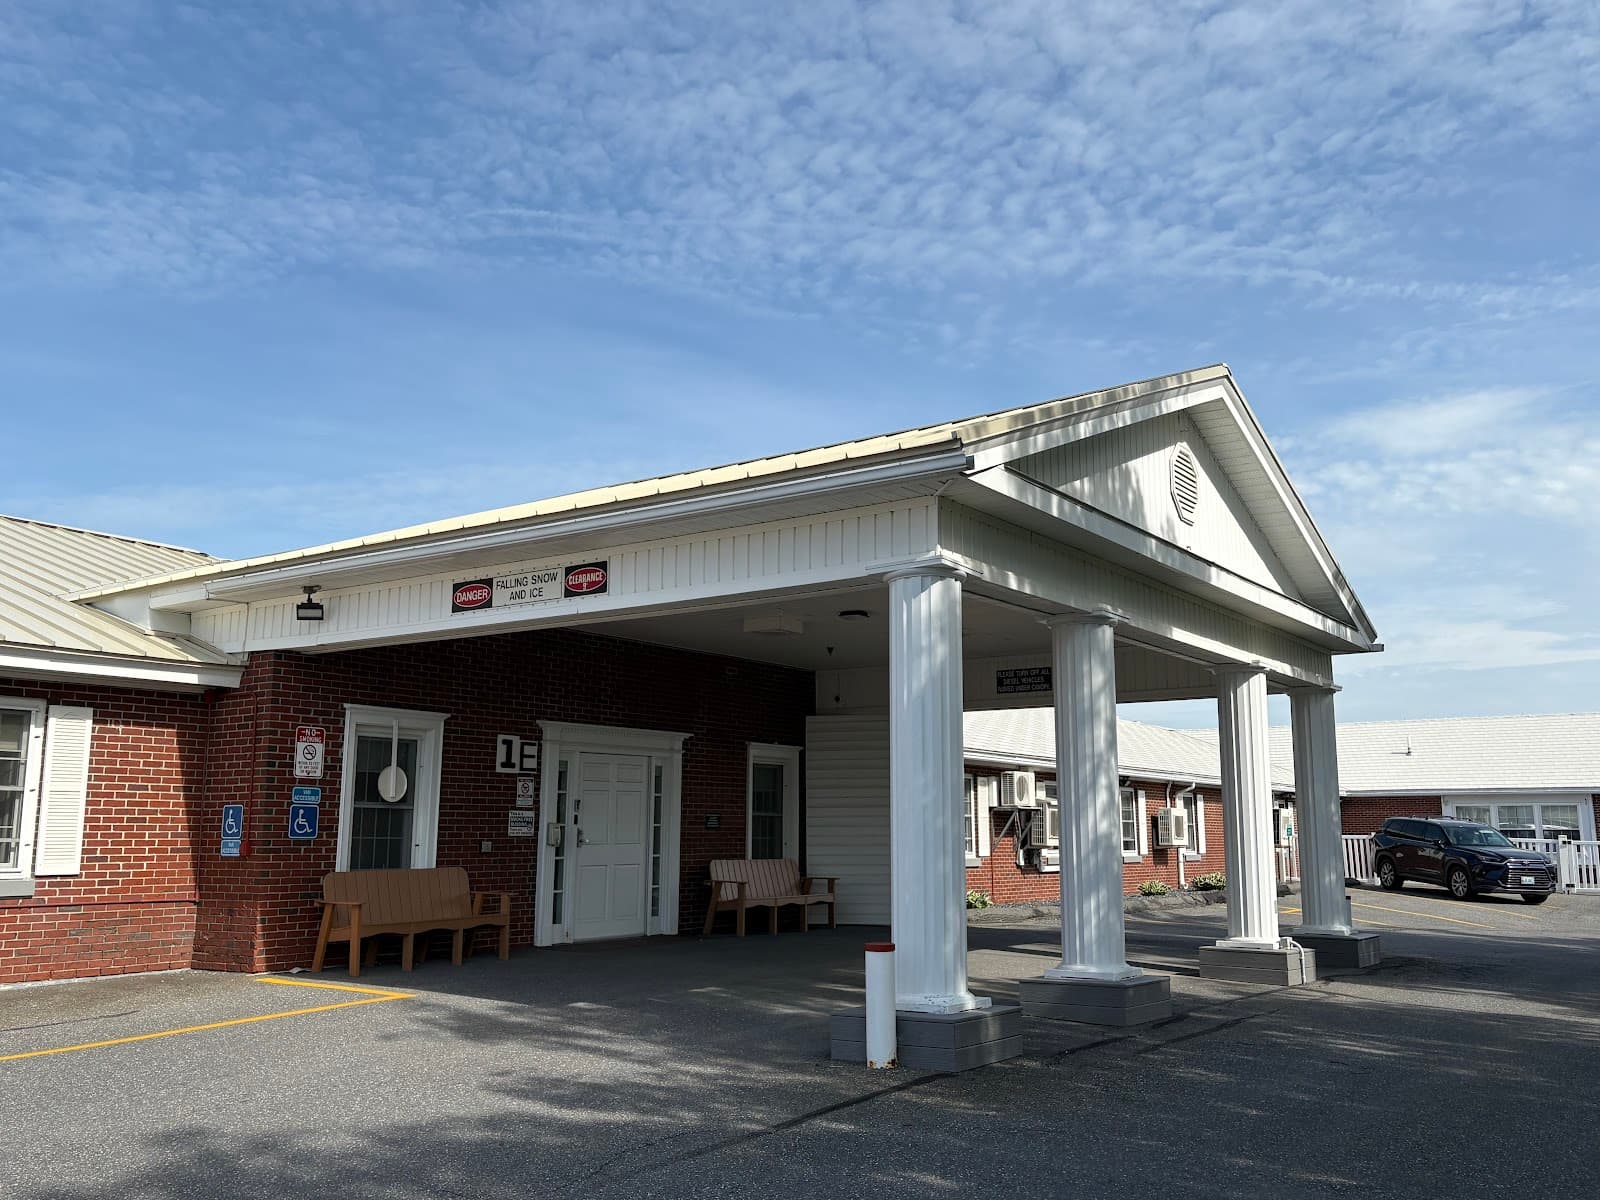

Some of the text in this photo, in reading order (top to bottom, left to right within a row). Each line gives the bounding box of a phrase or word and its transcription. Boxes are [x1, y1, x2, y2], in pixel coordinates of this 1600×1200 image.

[496, 572, 558, 590] FALLING SNOW
[568, 571, 603, 585] CLEARANCE
[456, 588, 488, 603] DANGER
[509, 587, 544, 601] AND ICE
[299, 735, 322, 743] SMOKING
